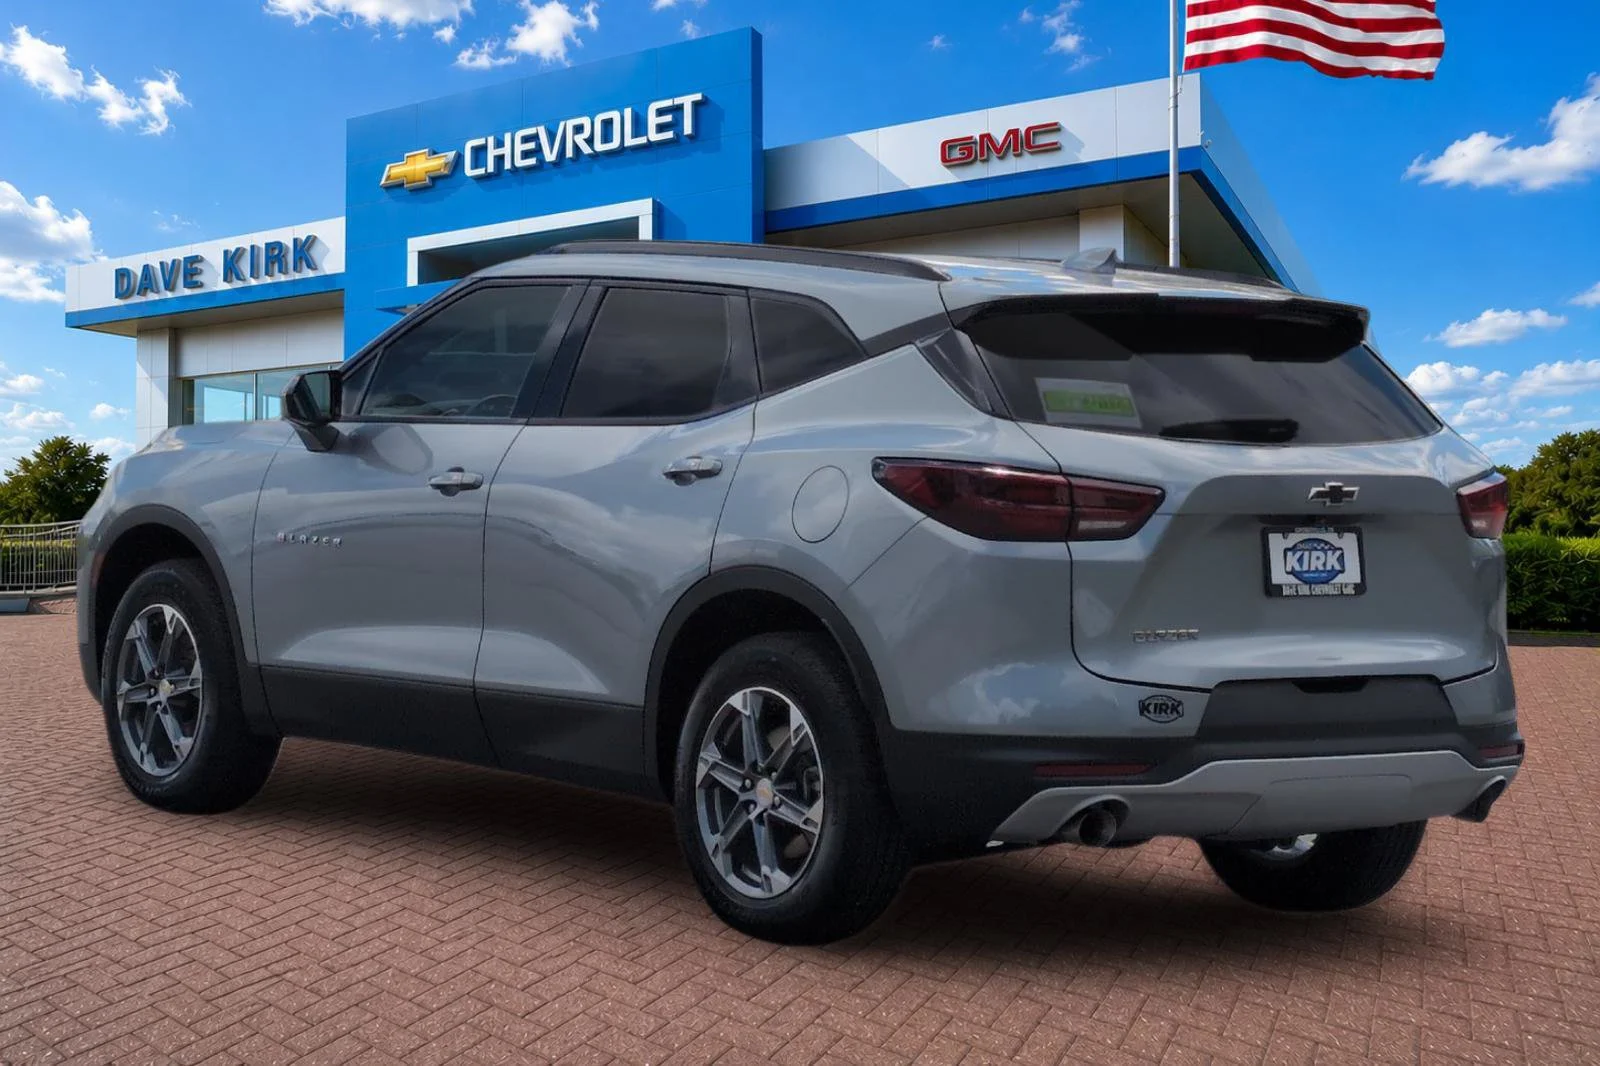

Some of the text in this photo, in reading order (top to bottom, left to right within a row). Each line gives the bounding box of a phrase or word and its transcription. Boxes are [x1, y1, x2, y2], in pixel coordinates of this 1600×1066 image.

[464, 92, 704, 178] CHEVROLET
[939, 121, 1061, 167] GMC
[114, 233, 319, 300] DAVE KIRK
[1285, 550, 1343, 572] KIRK
[1141, 702, 1181, 715] KIRK
